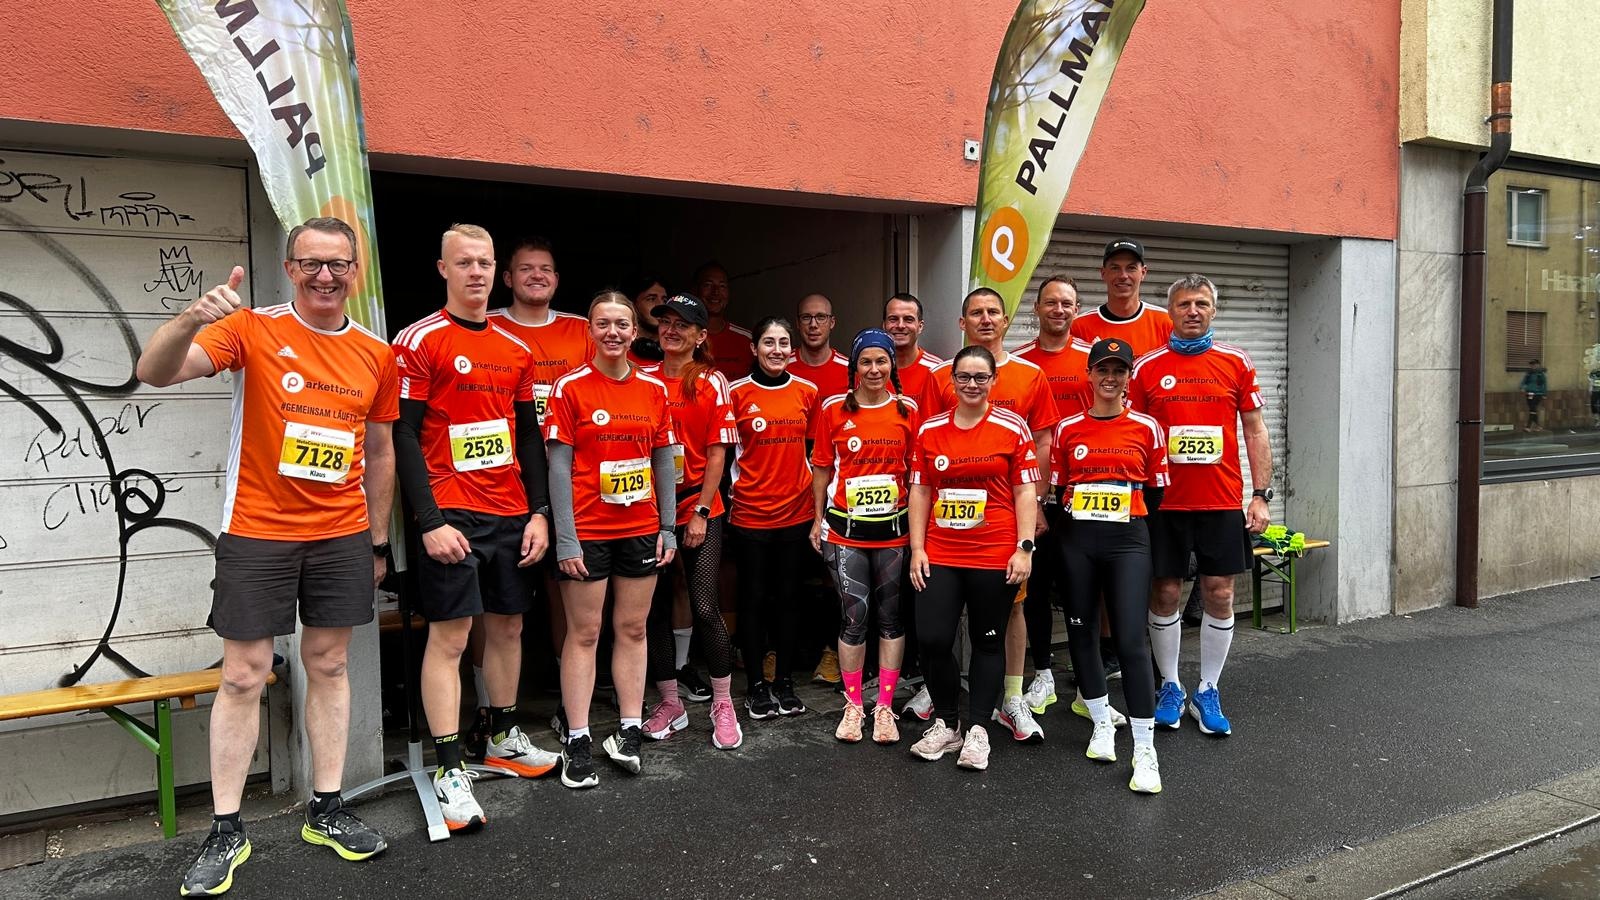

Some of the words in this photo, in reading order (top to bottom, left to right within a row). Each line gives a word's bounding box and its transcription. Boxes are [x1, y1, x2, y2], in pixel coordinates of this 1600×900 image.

[1015, 0, 1115, 195] PALLMA
[24, 402, 162, 473] Paper
[463, 437, 504, 459] 2528
[1178, 440, 1215, 454] 2523
[295, 444, 344, 470] 7128
[309, 470, 327, 478] Klaus
[610, 474, 645, 494] 7129
[855, 489, 892, 506] 2522
[1082, 495, 1121, 512] 7119
[941, 503, 976, 519] 7130
